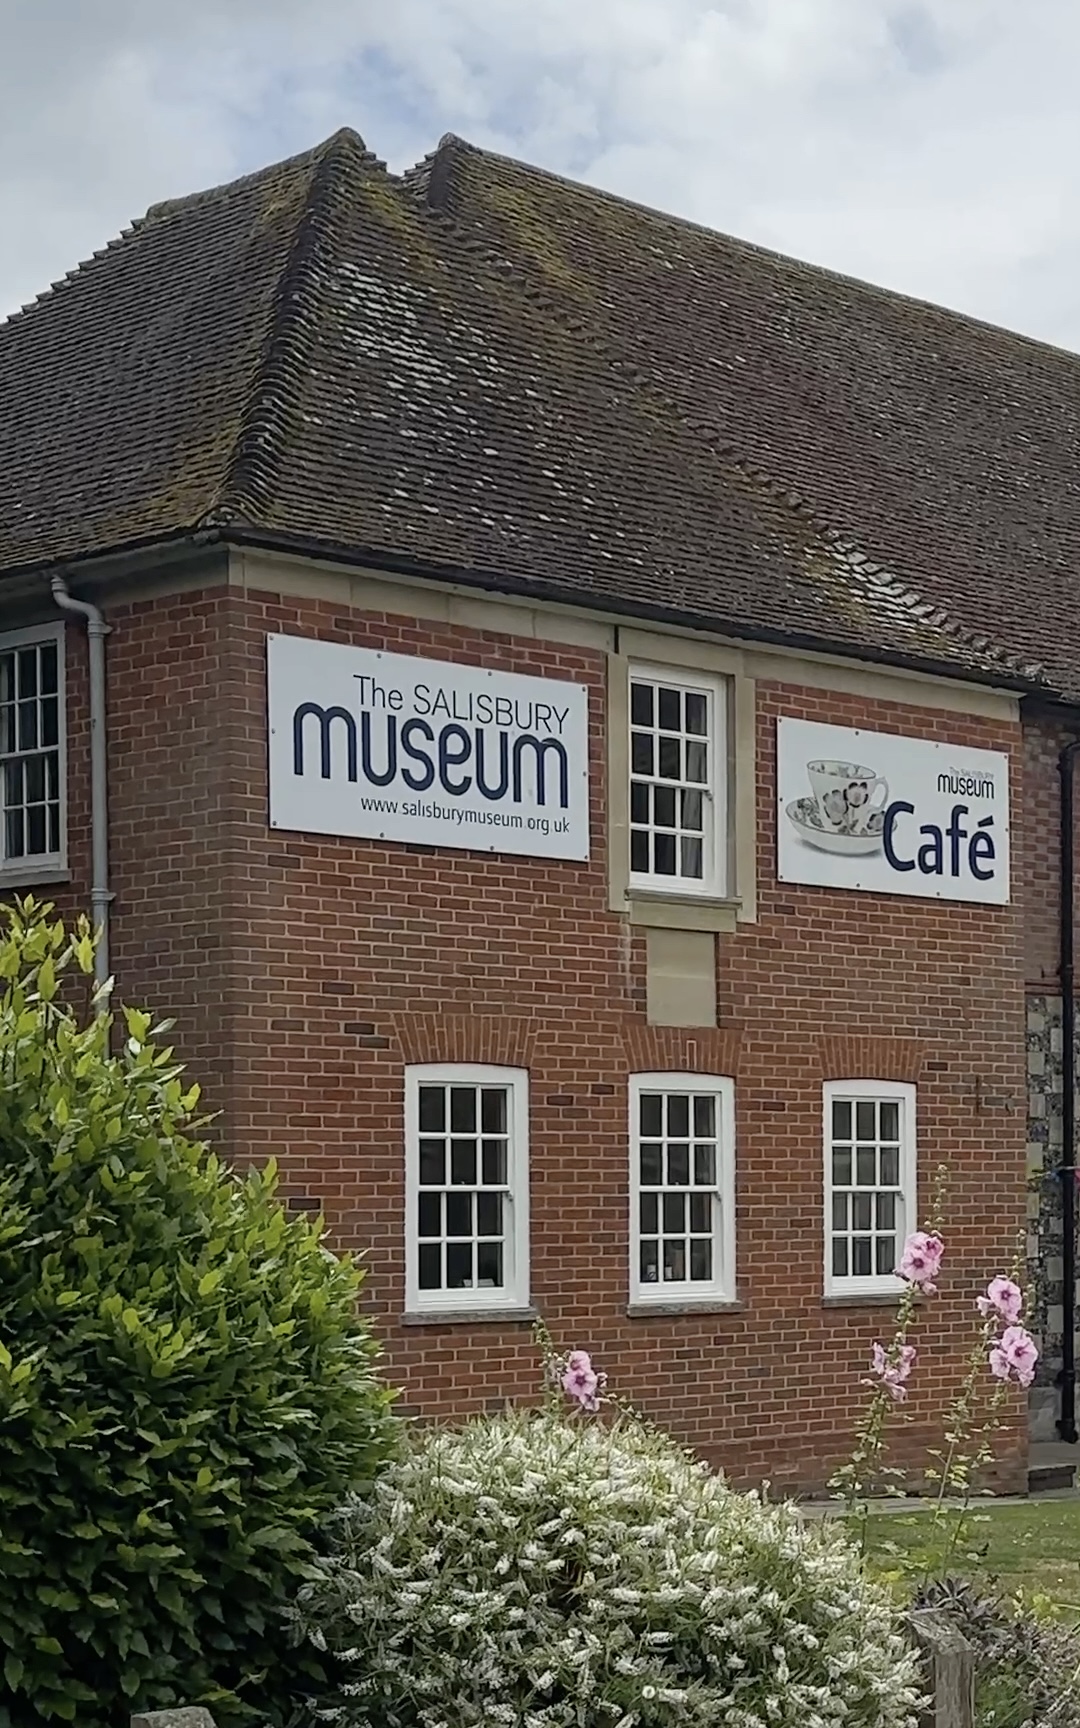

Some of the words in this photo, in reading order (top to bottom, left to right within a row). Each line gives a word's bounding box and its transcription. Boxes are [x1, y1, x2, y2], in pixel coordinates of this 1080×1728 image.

[353, 674, 403, 710] The
[413, 684, 569, 735] SALISBURY
[293, 702, 568, 808] museum
[938, 773, 994, 799] museum
[883, 801, 995, 881] Café
